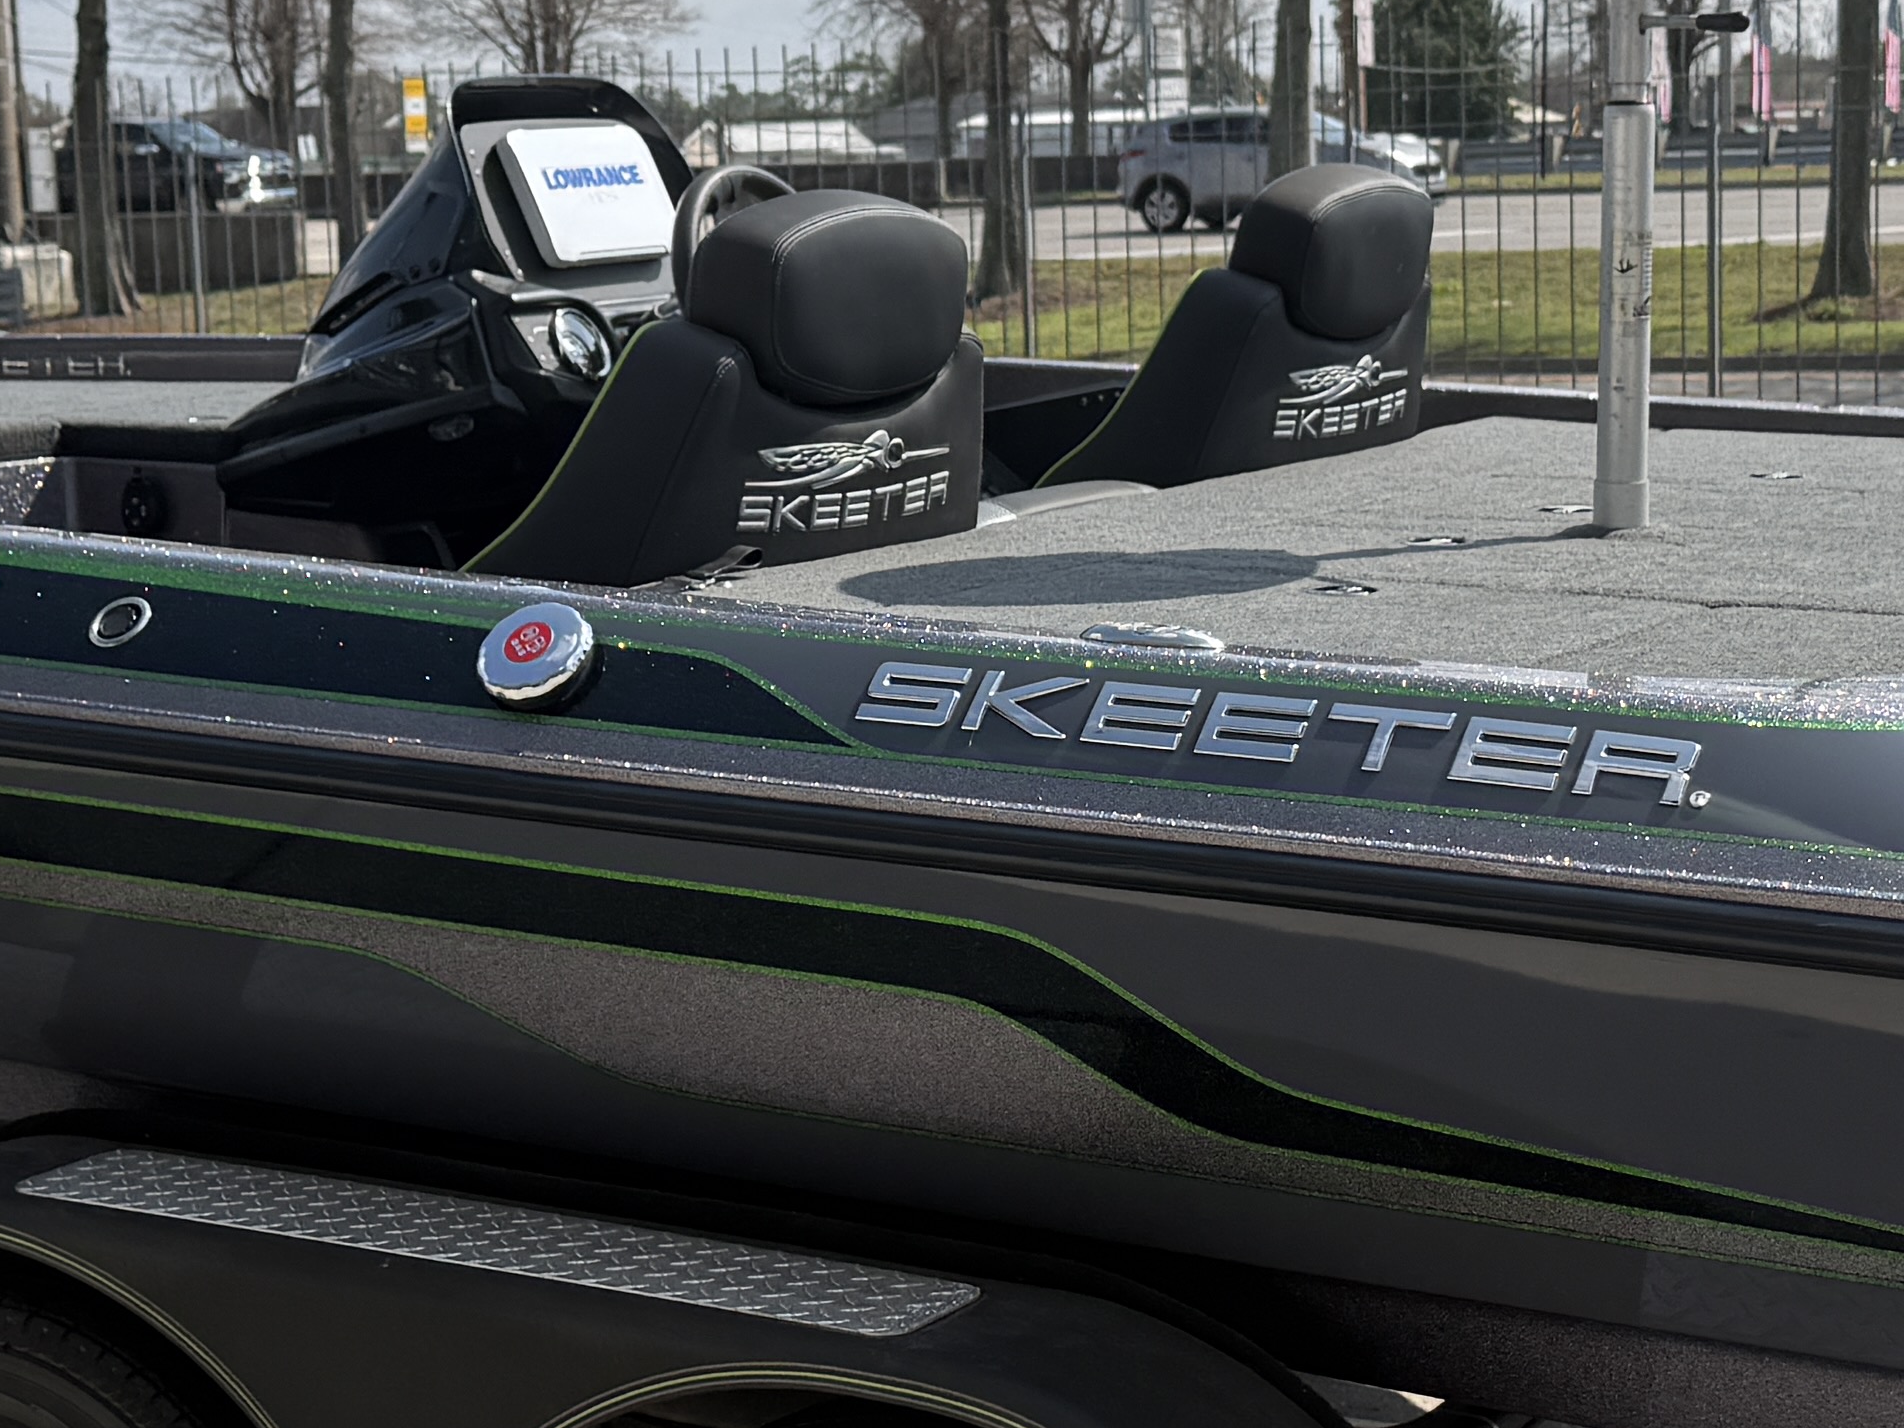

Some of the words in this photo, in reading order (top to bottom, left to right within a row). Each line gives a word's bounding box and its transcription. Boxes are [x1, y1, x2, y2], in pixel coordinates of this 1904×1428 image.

[541, 164, 645, 191] LOWRANCE
[1273, 388, 1408, 441] SKEETER
[736, 470, 950, 535] SKEETER
[854, 660, 1702, 807] SKEETER
